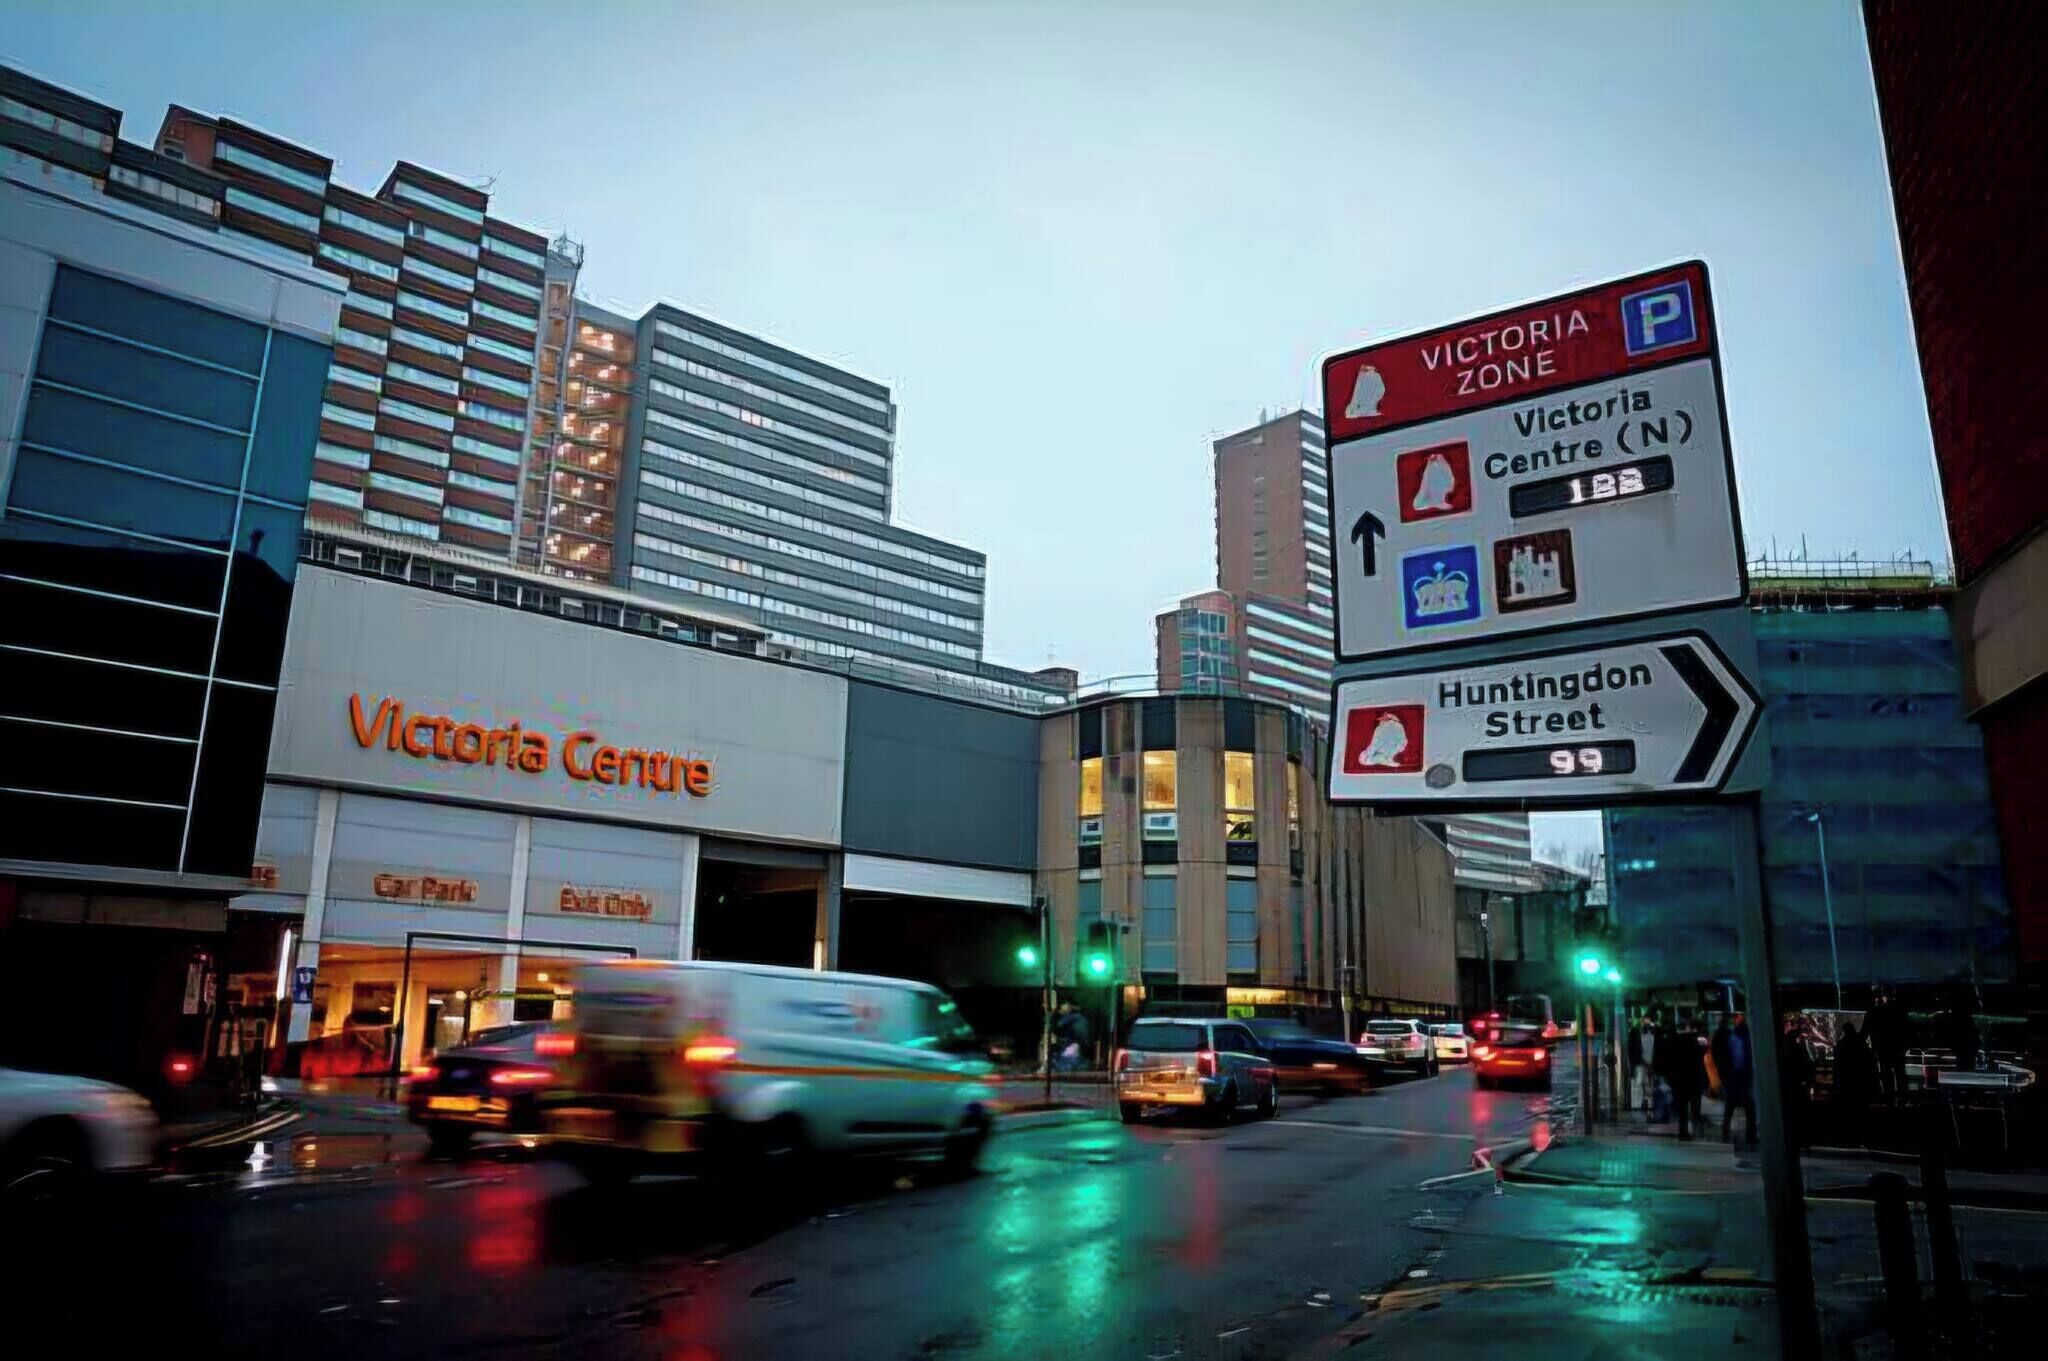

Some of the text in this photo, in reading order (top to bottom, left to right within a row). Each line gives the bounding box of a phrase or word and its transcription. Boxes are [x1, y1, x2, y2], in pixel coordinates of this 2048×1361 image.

[1420, 309, 1590, 372] VICTORIA
[1456, 349, 1557, 396] ZONE
[1513, 388, 1653, 437] Victoria
[1484, 409, 1694, 480] Centre (N)
[1438, 662, 1652, 708] Huntingdon
[1485, 702, 1606, 738] Street
[348, 691, 715, 798] Victoria Centre
[1549, 748, 1603, 775] 99
